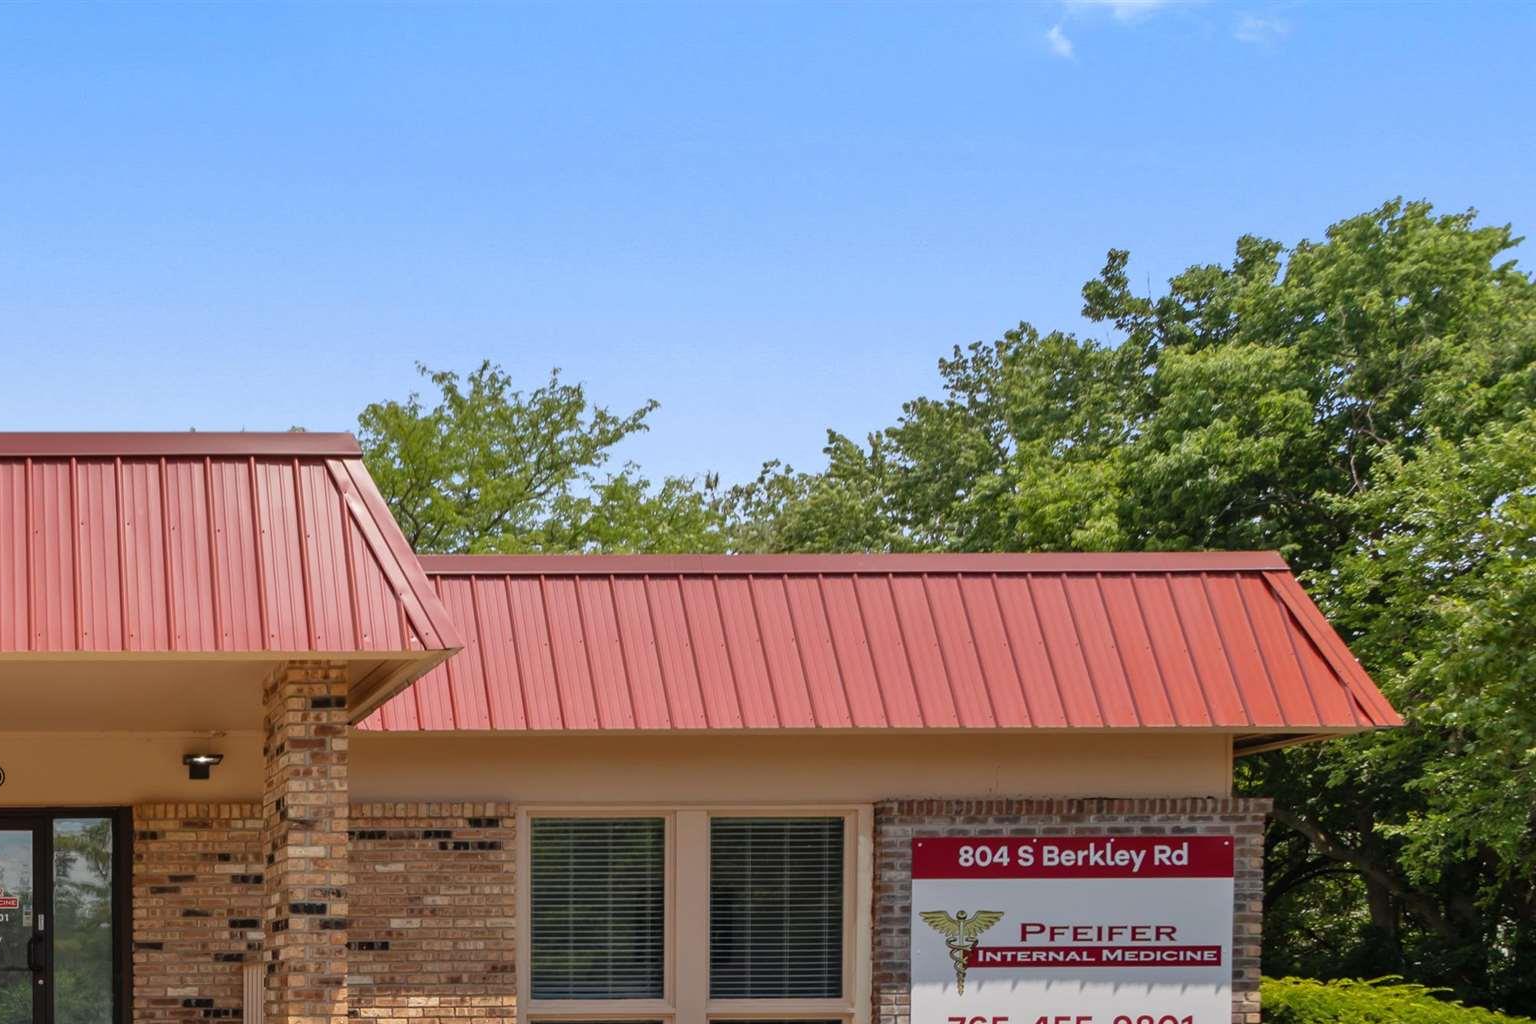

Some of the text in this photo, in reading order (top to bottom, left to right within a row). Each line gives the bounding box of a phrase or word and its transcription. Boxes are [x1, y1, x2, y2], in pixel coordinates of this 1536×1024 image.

[958, 842, 1189, 872] 804 S Berkley Rd
[1019, 922, 1178, 942] PFEIFER
[977, 948, 1217, 963] INTERNAL MEDICINE
